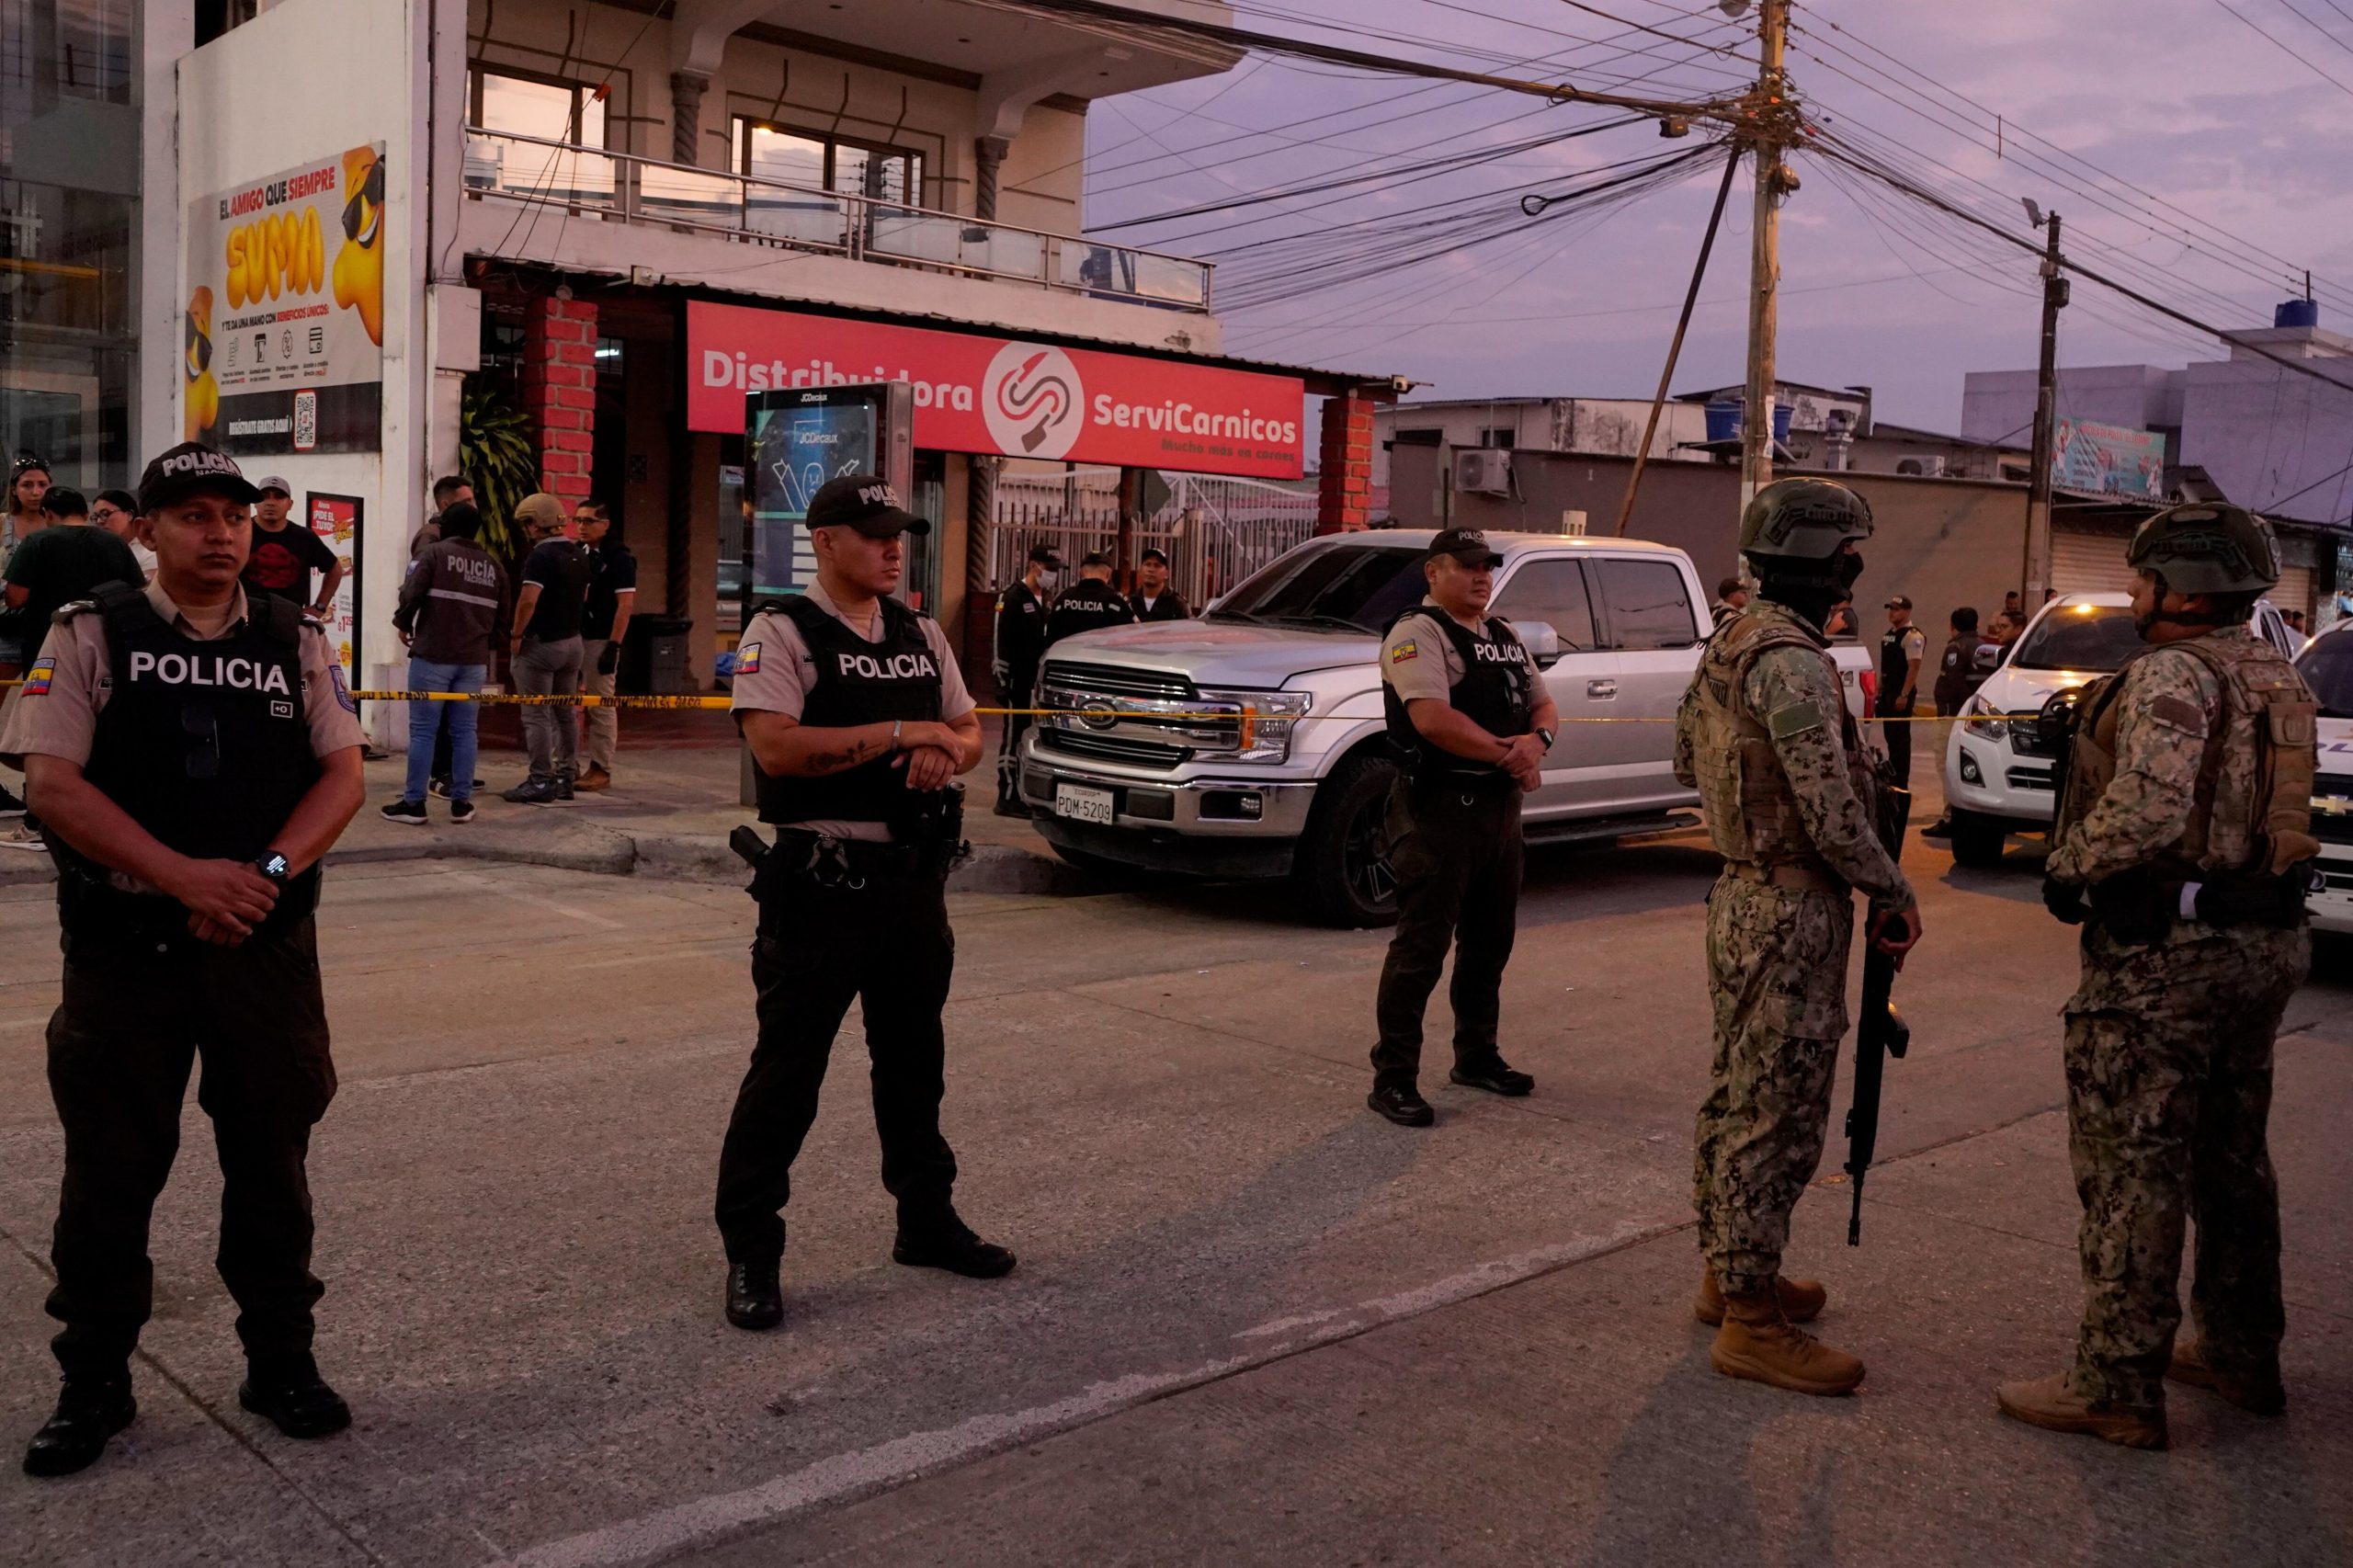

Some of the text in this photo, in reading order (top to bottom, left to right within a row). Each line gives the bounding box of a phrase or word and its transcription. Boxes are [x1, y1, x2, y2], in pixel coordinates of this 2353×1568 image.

[221, 166, 335, 221] EL AMIGO QUE SIEMPRE
[226, 205, 324, 311] SUMA
[239, 318, 249, 329] UNA
[249, 315, 265, 327] MANO
[266, 313, 276, 324] CON
[277, 308, 306, 323] BENEFICIOS
[704, 350, 972, 412] Distribora
[801, 393, 828, 403] JCDecaux
[1094, 394, 1296, 444] ServiCarnicos
[800, 432, 838, 444] JCDecaux
[1162, 438, 1203, 453] Mucho
[1256, 449, 1294, 461] carnes
[163, 451, 243, 478] POLICIA
[858, 484, 898, 505] POLIC
[1459, 531, 1484, 541] POLIC
[447, 555, 496, 580] POLICÍA
[463, 574, 495, 587] NACIONAL
[1063, 599, 1104, 611] POLICIA
[1474, 643, 1526, 663] POLICIA
[130, 651, 290, 696] POLICIA
[838, 653, 937, 679] POLICIA
[1059, 797, 1110, 821] PDM-5209
